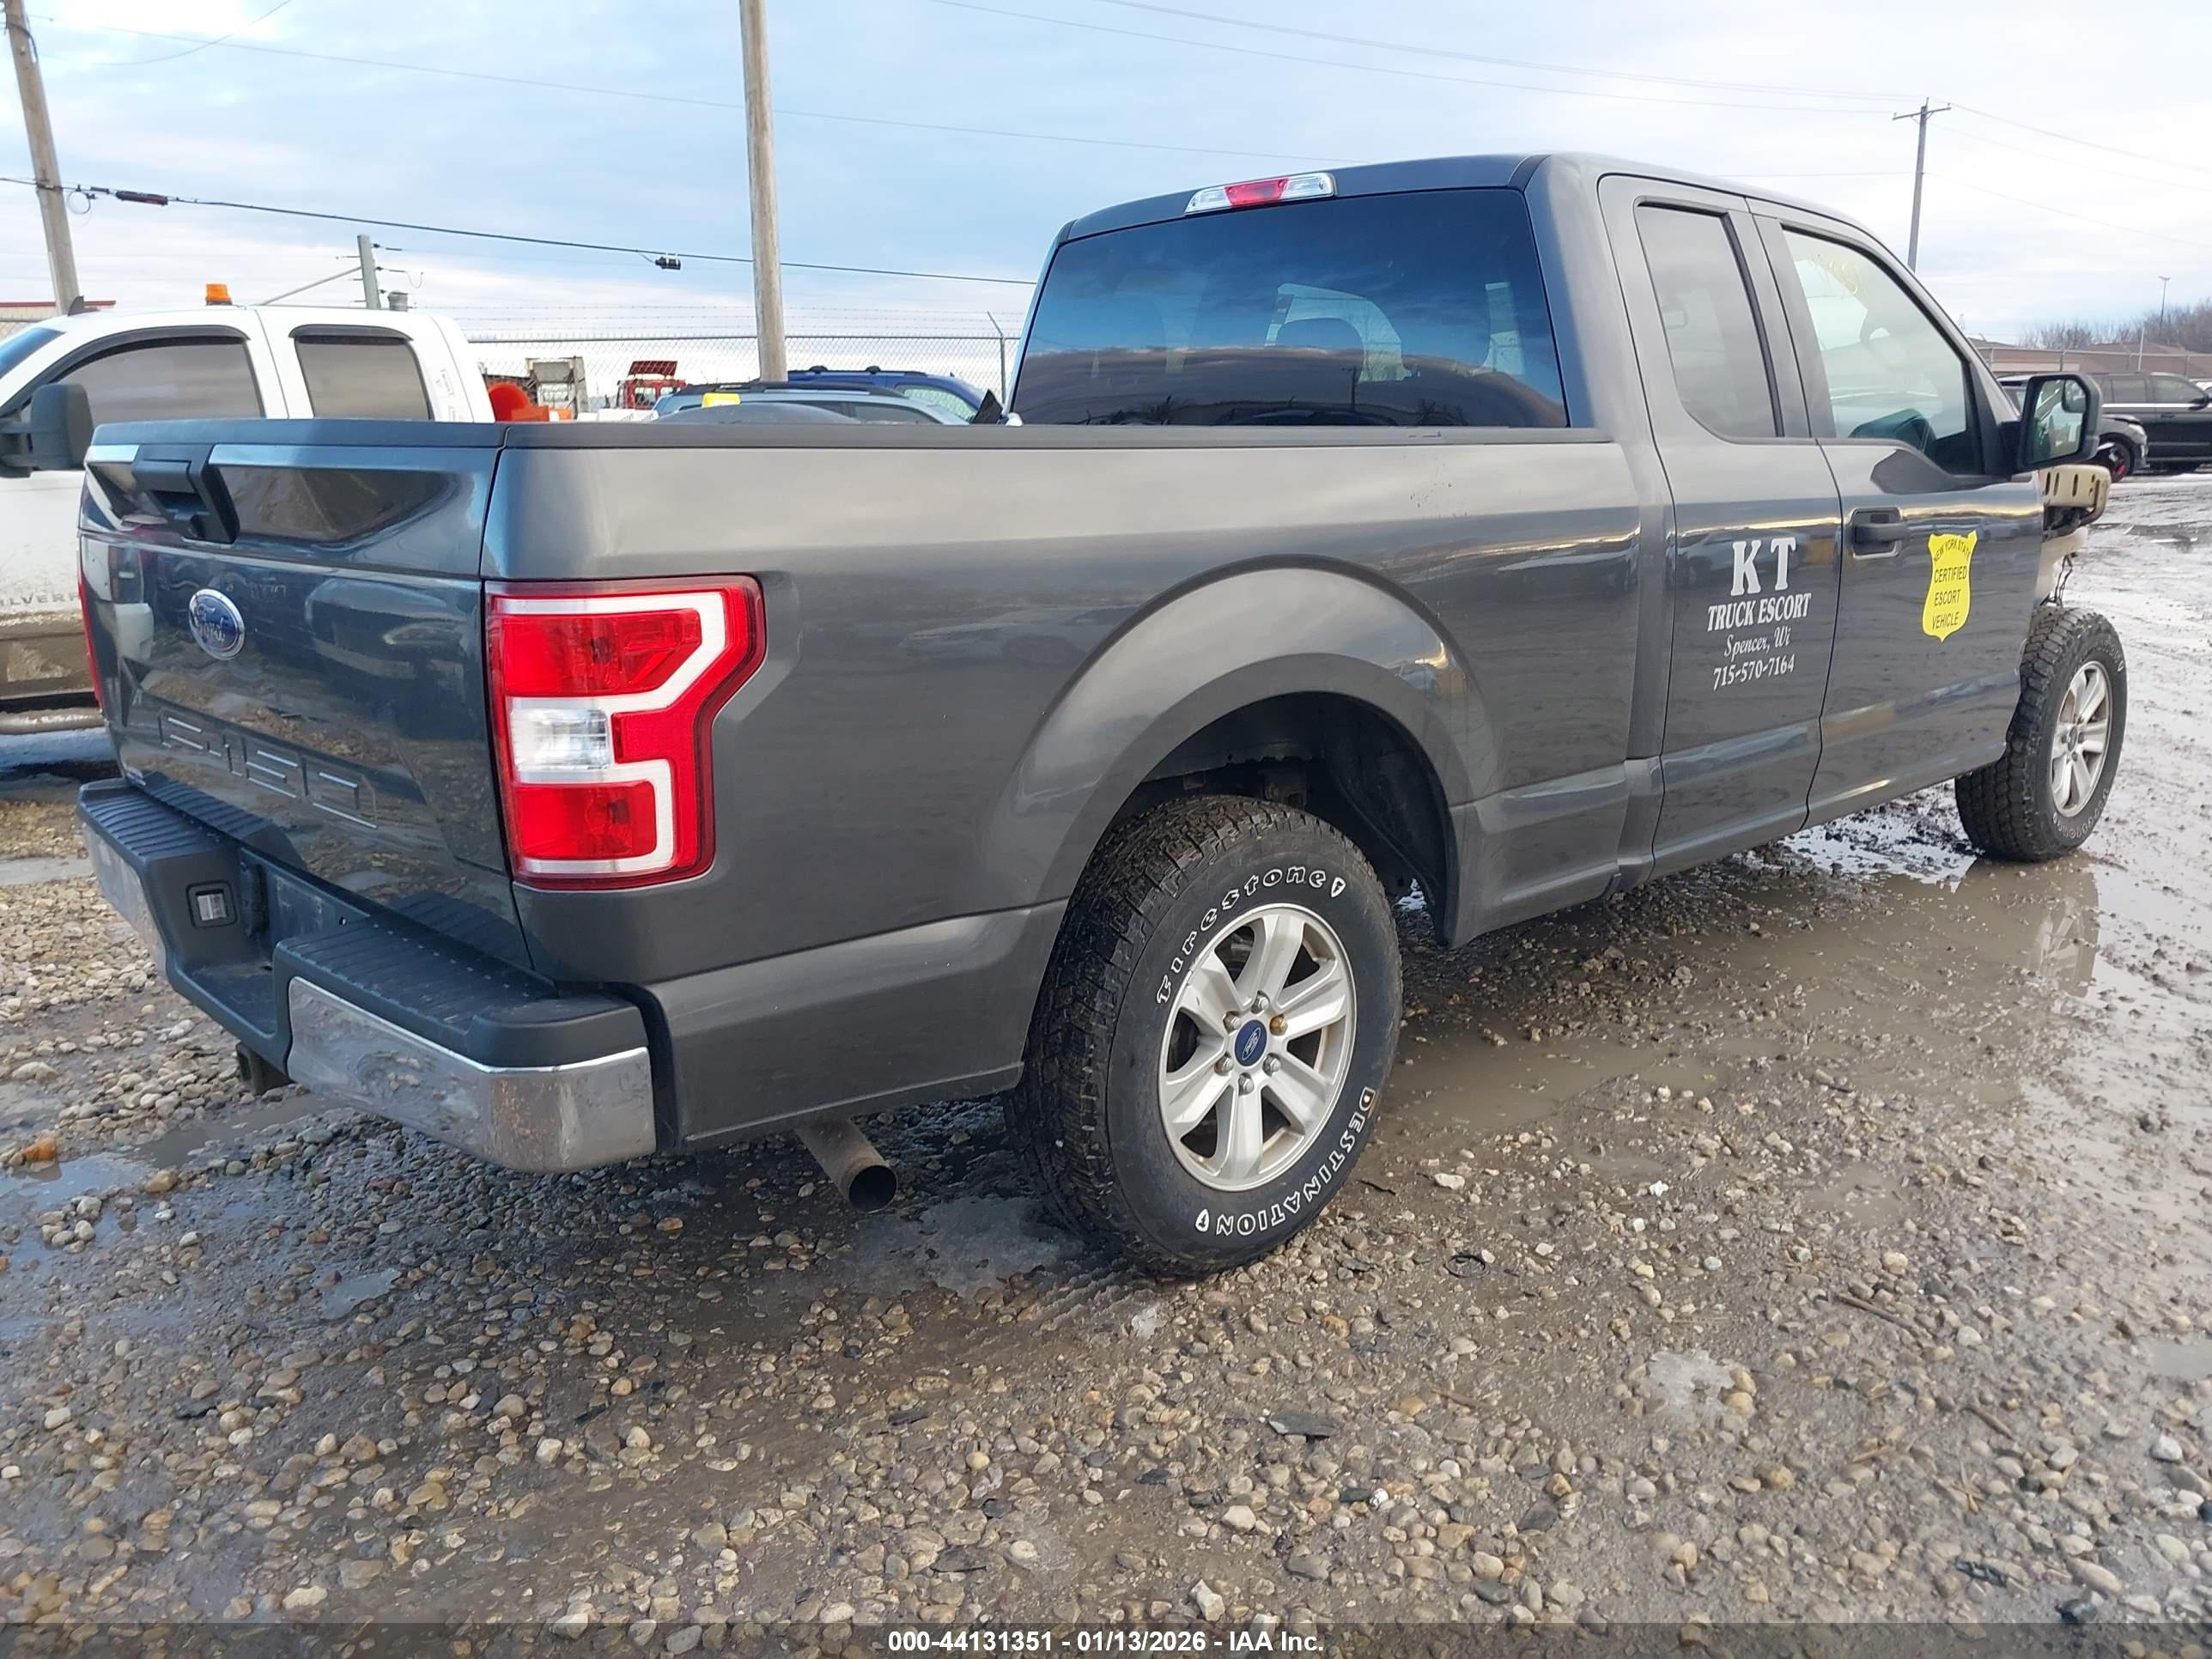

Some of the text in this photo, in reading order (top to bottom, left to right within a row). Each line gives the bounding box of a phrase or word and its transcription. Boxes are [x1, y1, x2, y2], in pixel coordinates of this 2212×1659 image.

[1730, 536, 1796, 596] K T
[1944, 538, 1958, 552] YORK
[1958, 539, 1972, 558] STATE
[1934, 566, 1967, 583] CERTIFIED
[1707, 592, 1812, 633] TRUCK ESCORT
[1934, 589, 1961, 606] ESCORT
[1932, 611, 1960, 630] VEHICLE
[1723, 625, 1792, 662] Spencer, Wi
[1713, 653, 1796, 692] 715-570-7164
[1156, 866, 1327, 1005] Firestone
[1215, 1085, 1376, 1236] DESTINATION
